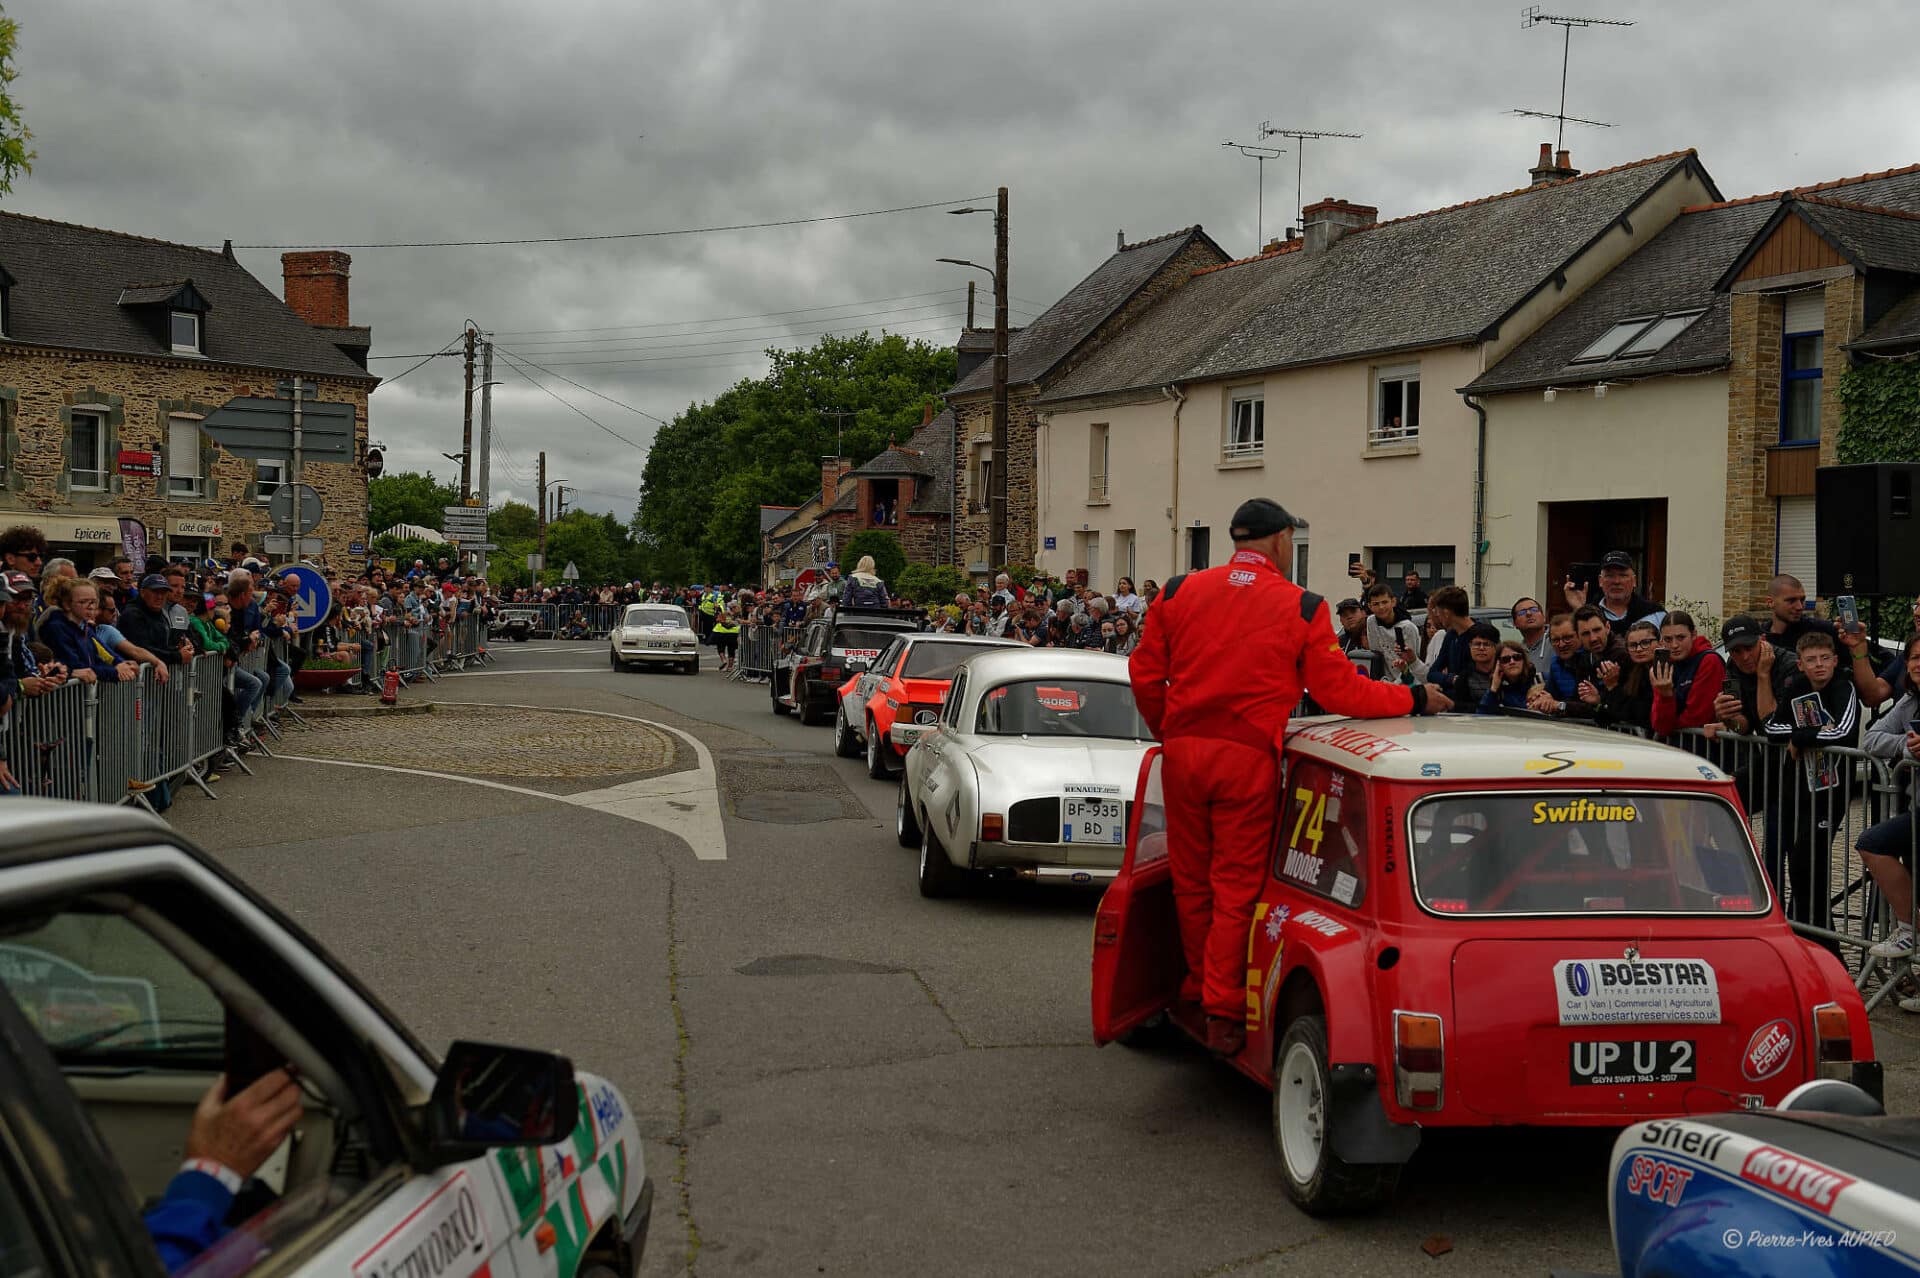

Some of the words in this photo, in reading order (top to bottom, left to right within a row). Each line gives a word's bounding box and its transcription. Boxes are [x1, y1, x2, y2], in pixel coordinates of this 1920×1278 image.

[74, 527, 111, 541] Epicerie
[179, 522, 195, 532] Côté
[197, 523, 213, 533] Café
[845, 649, 878, 657] PIPER
[1068, 803, 1119, 818] BF-935
[1290, 787, 1327, 856] 74
[1532, 798, 1637, 824] Swiftune
[1084, 822, 1102, 835] BD
[1282, 848, 1325, 885] MOORE
[1599, 963, 1708, 986] BOESTAR
[1635, 987, 1687, 995] SERVICES
[1566, 1001, 1582, 1009] Car
[1614, 1000, 1662, 1008] Commercial
[1669, 1000, 1713, 1009] Agricultural
[1563, 1011, 1719, 1022] www.boestartyreservices.co.uk
[1749, 1025, 1783, 1065] KENT
[1755, 1034, 1791, 1075] CAMS
[1573, 1041, 1621, 1076] UP
[1633, 1041, 1657, 1075] U
[1669, 1040, 1693, 1074] 2
[1615, 1075, 1636, 1084] SWIFT
[1661, 1074, 1678, 1082] 2017
[1641, 1121, 1731, 1161] Shell
[1627, 1155, 1695, 1208] SPORT
[1745, 1150, 1842, 1206] MOTUL
